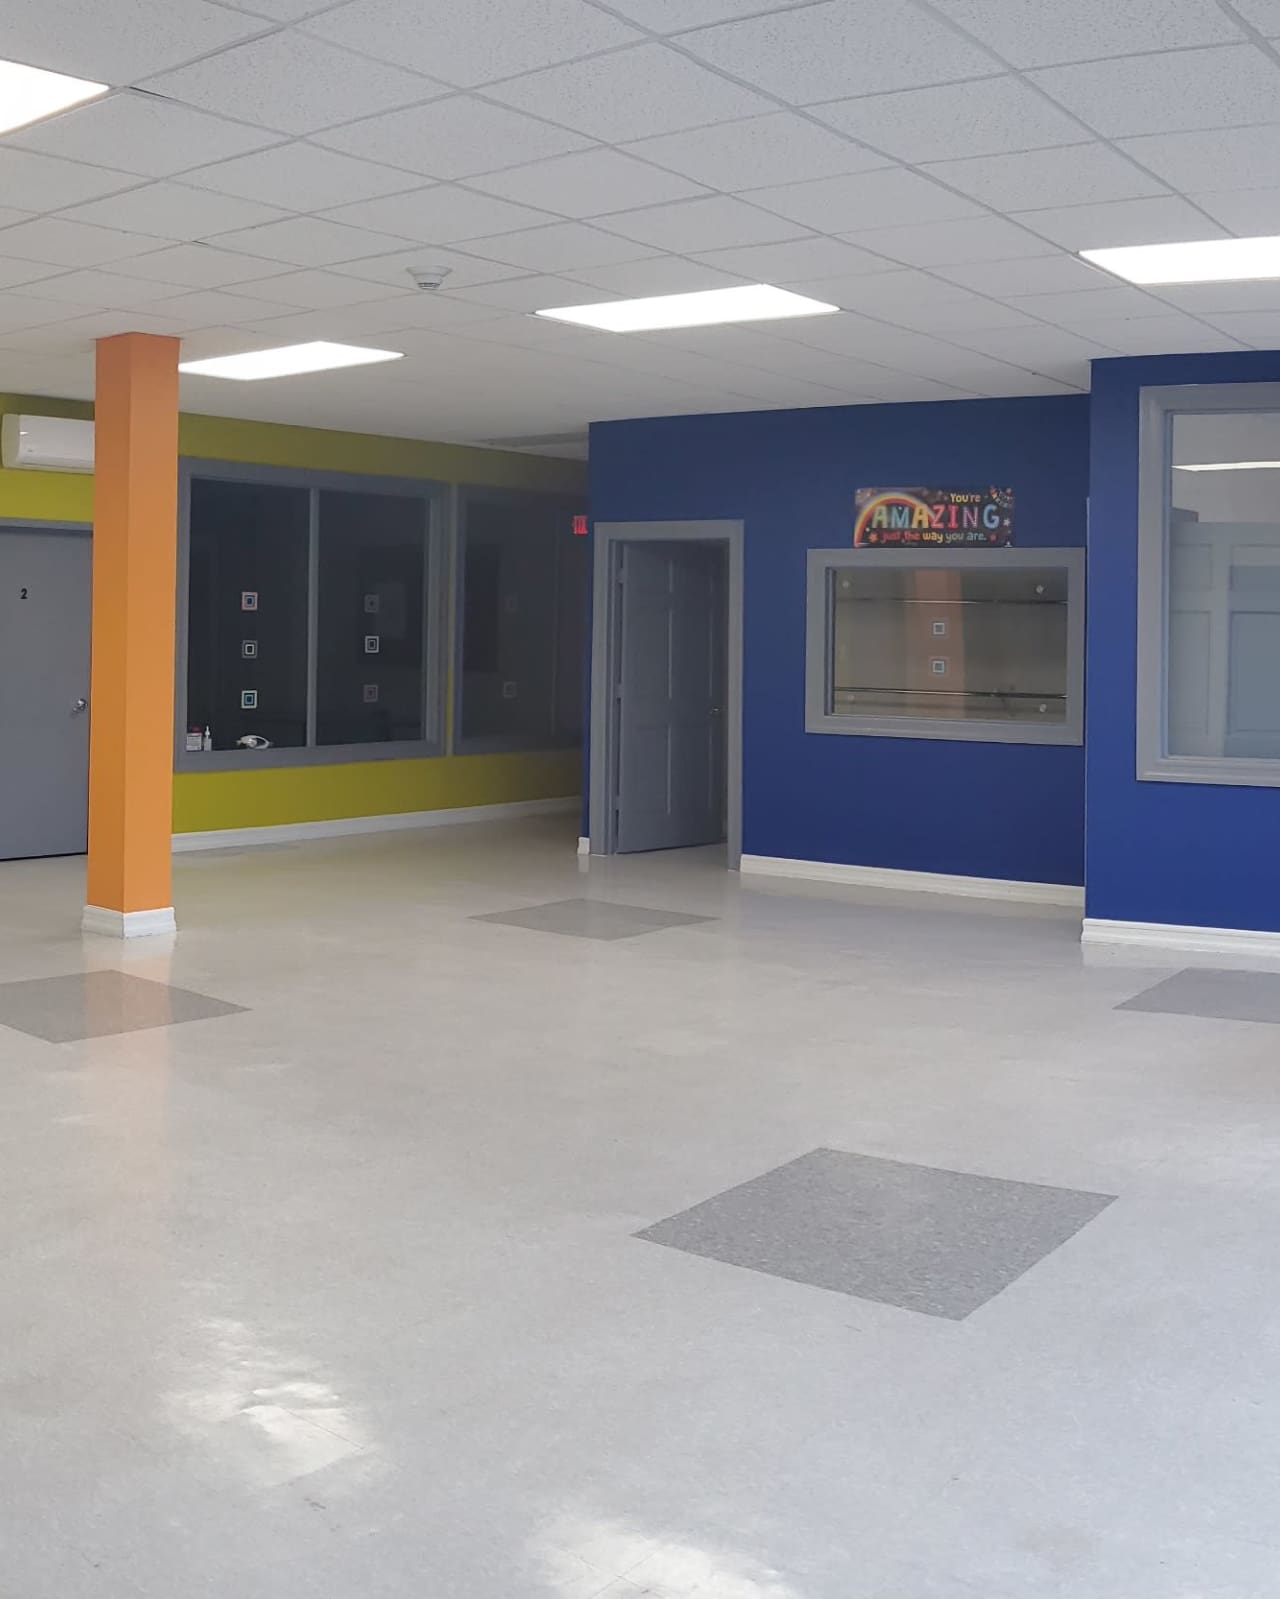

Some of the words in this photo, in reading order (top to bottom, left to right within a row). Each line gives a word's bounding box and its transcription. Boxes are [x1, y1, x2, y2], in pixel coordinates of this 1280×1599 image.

[950, 493, 981, 503] You're
[871, 503, 1000, 529] AMAZING
[881, 532, 901, 542] just
[903, 531, 920, 541] the
[922, 532, 944, 543] way
[945, 533, 964, 543] you
[966, 531, 987, 541] are.
[20, 588, 28, 600] 2
